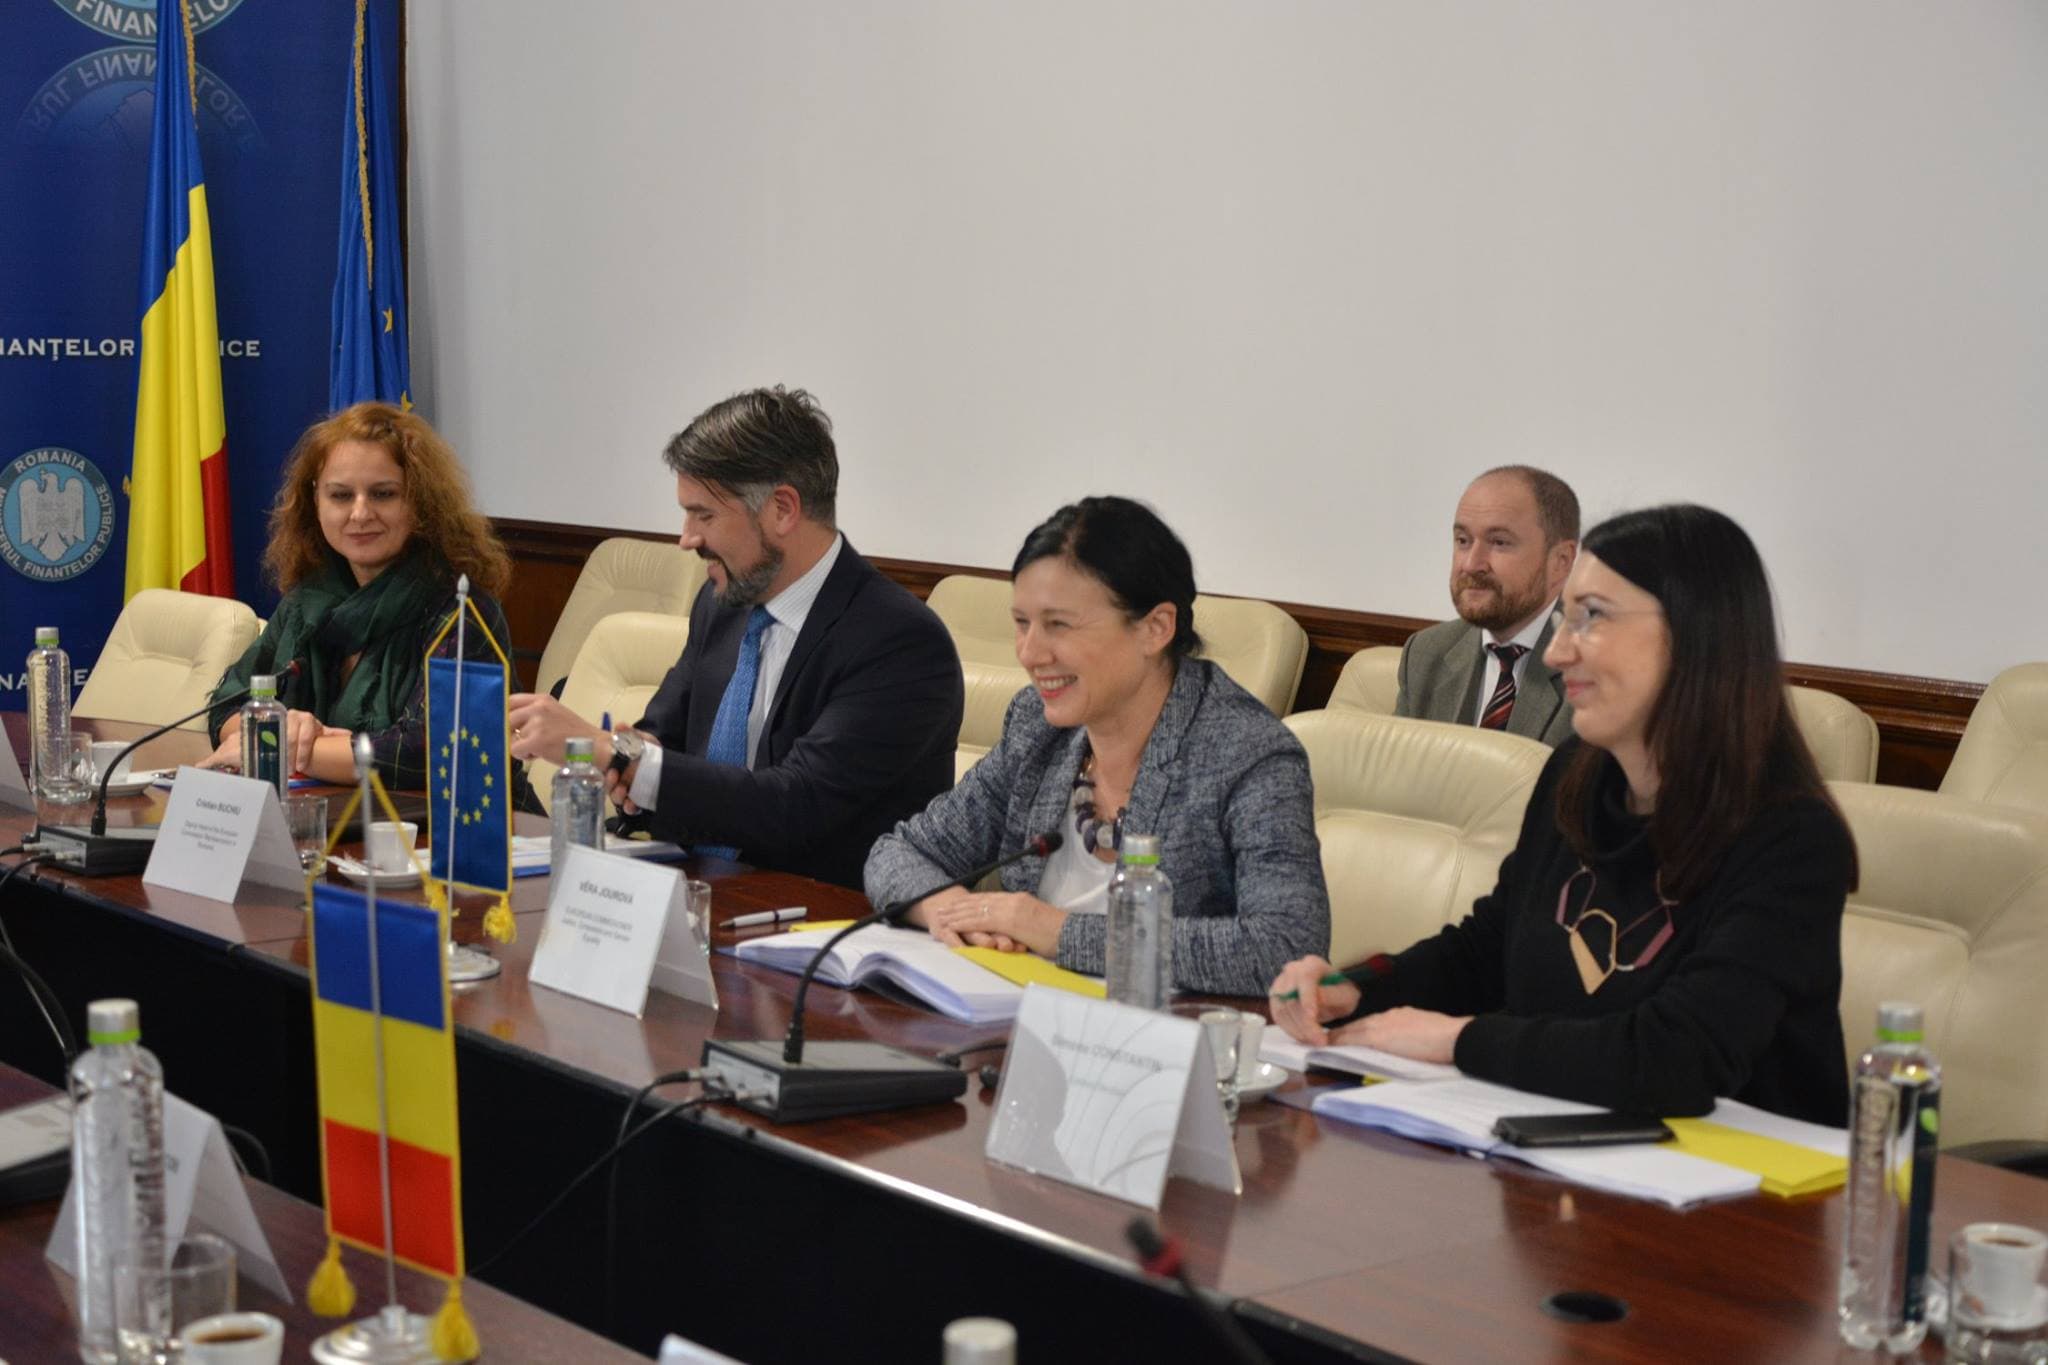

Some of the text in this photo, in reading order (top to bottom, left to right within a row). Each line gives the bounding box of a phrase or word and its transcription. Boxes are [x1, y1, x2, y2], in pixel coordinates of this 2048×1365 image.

[14, 450, 86, 474] ROMANIA
[23, 483, 112, 577] FINANTELOR PUBLICE
